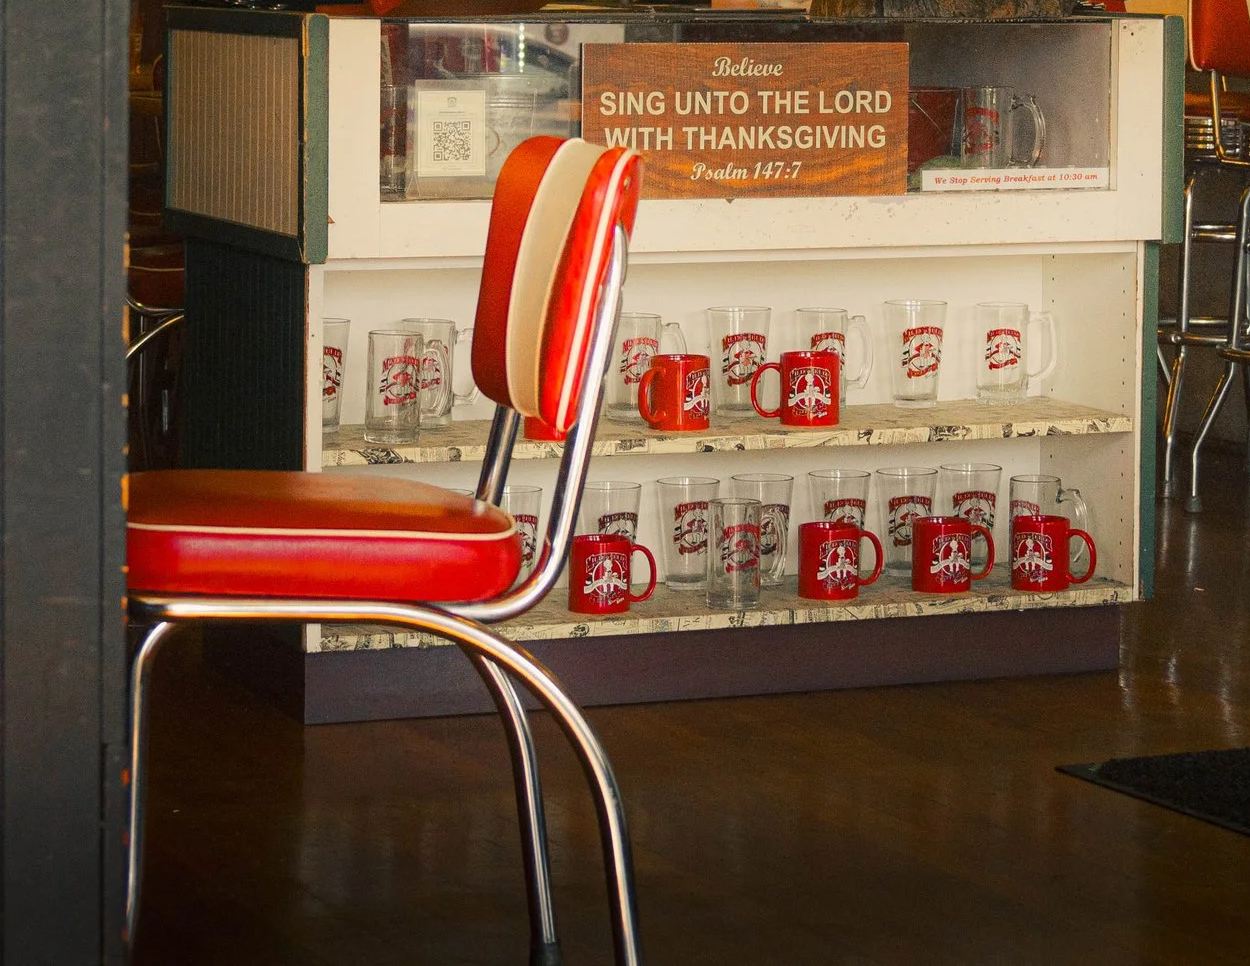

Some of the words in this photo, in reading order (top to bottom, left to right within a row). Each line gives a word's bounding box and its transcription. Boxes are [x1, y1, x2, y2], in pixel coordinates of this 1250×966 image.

[712, 56, 784, 77] Believe
[600, 91, 666, 116] SING
[675, 90, 749, 115] UNTO
[757, 90, 810, 114] THE
[819, 90, 892, 114] LORD
[604, 126, 673, 151] WITH
[682, 124, 886, 151] THANKSGIVING
[690, 162, 748, 181] Psalm
[753, 161, 802, 179] 147:7
[934, 177, 947, 185] We
[950, 176, 968, 186] Stop
[970, 176, 1000, 186] Serving
[1004, 174, 1046, 184] Breakfast
[1048, 174, 1056, 182] at
[1059, 174, 1083, 182] 10:30
